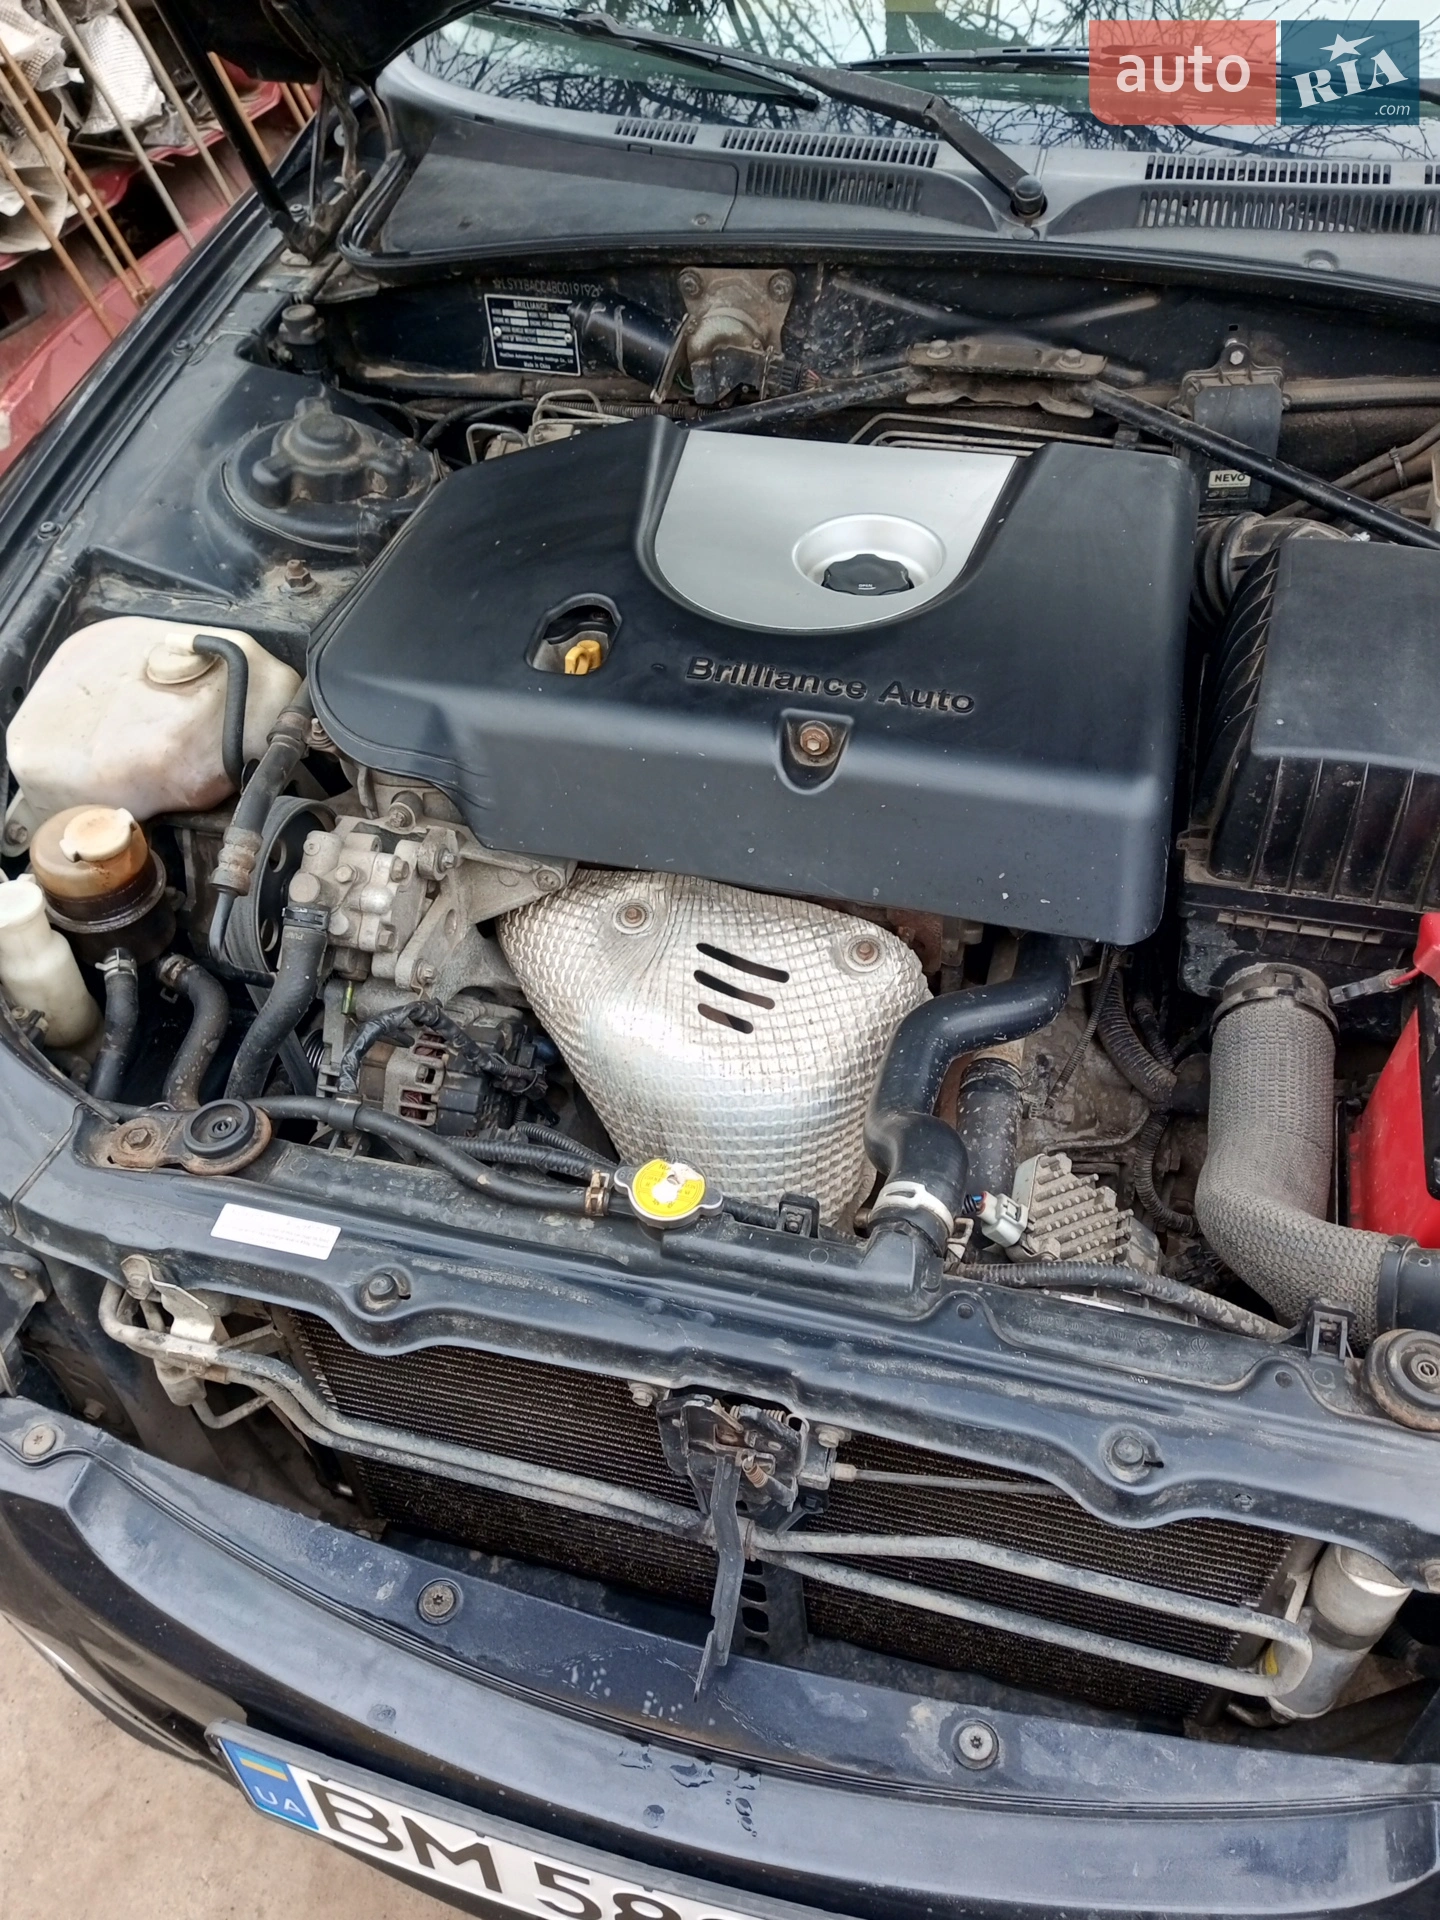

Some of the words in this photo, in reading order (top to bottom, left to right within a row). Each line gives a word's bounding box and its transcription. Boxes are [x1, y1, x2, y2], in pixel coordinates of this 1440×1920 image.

[513, 300, 549, 311] BRILLIANCE
[1214, 473, 1246, 483] NEVO
[685, 655, 868, 701] Brilliance
[877, 680, 976, 715] Auto
[254, 1785, 307, 1818] UA
[307, 1779, 502, 1894] BM
